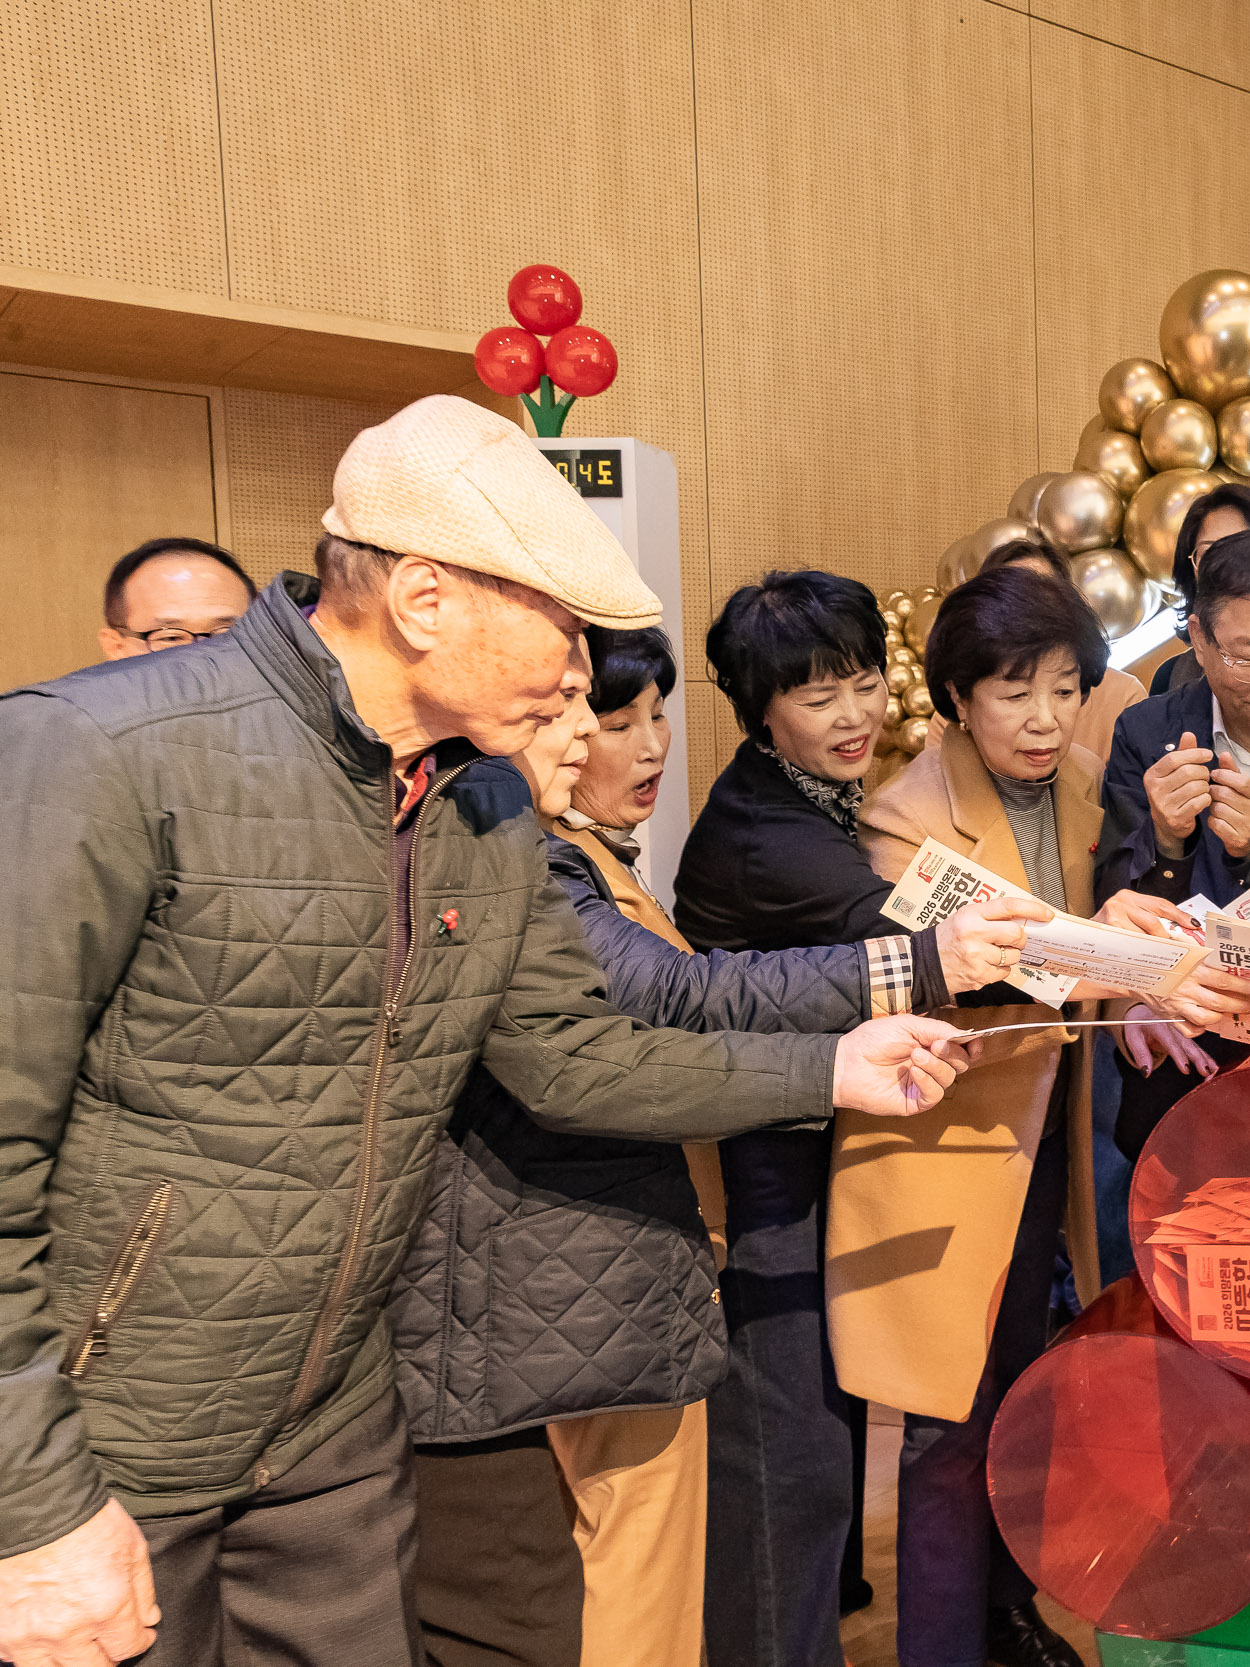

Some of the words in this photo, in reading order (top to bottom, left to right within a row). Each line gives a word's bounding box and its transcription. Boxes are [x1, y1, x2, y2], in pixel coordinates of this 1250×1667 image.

[916, 900, 937, 924] 2026
[931, 864, 961, 902] 희망온돌
[1219, 942, 1246, 953] 2026
[1223, 1304, 1234, 1330] 2026
